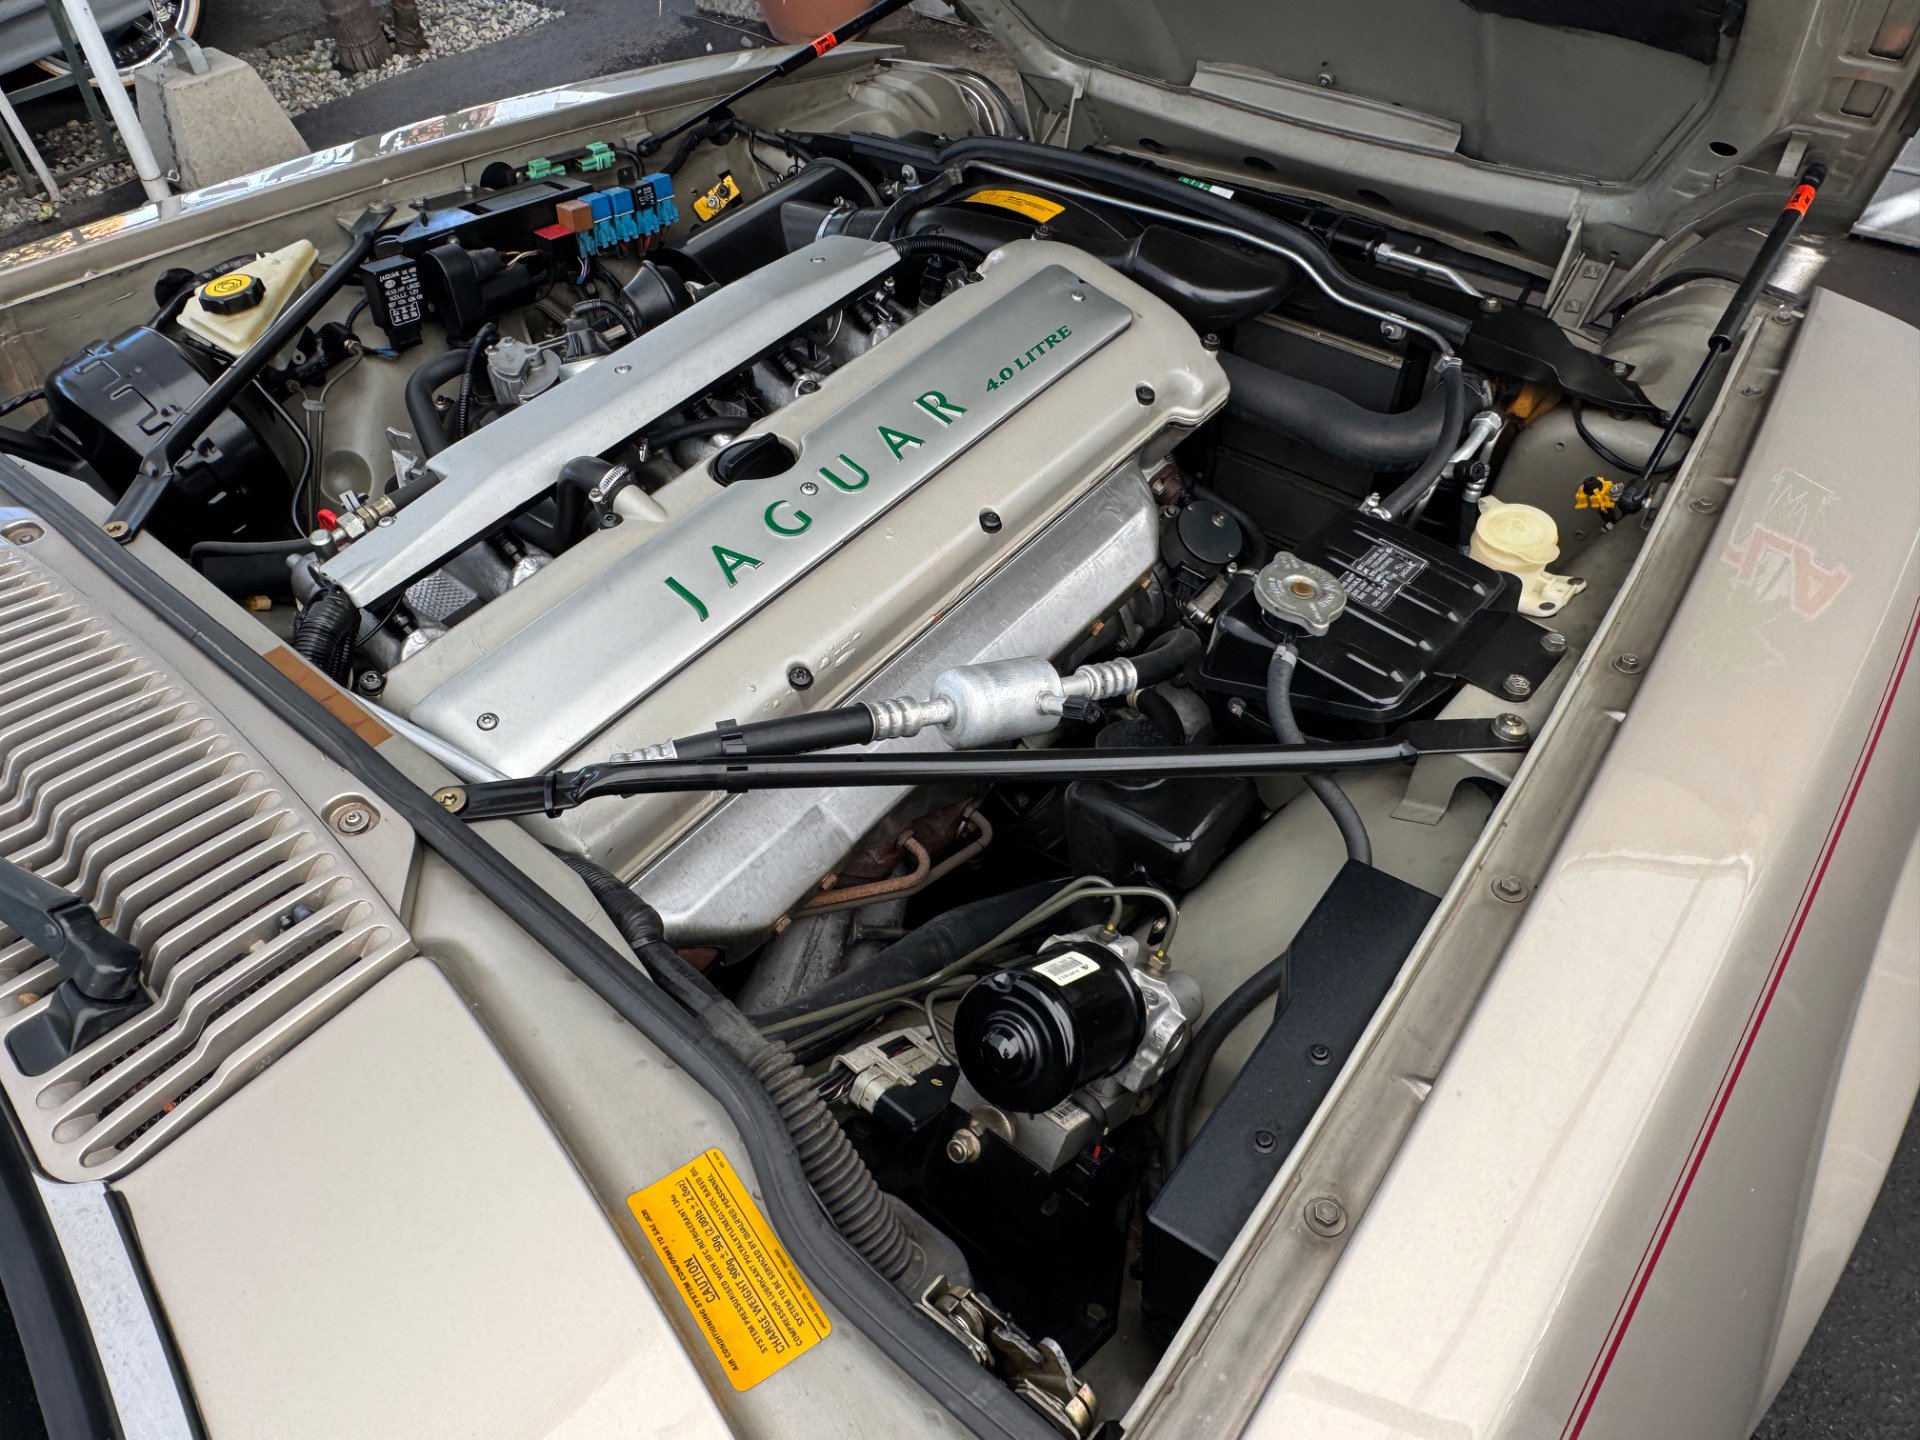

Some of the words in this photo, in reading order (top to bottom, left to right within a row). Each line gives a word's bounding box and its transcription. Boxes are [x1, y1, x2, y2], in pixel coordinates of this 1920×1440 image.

[986, 366, 1014, 392] 4.0
[1014, 325, 1072, 371] LITRE
[664, 390, 968, 622] JAGUAR
[694, 1176, 711, 1197] BASED
[705, 1172, 731, 1209] PERSONNEL
[688, 1201, 699, 1210] ±
[676, 1207, 706, 1249] REFRIGERANT
[727, 1207, 751, 1240] QUALIFIED
[656, 1235, 665, 1245] TO
[708, 1234, 726, 1252] 50g
[718, 1250, 728, 1260] ±
[746, 1238, 757, 1250] BY
[661, 1245, 687, 1281] CONFORMS
[709, 1261, 724, 1280] WITH
[722, 1257, 742, 1280] 900g
[752, 1248, 776, 1280] SERVICED
[682, 1256, 717, 1304] CAUTION
[682, 1280, 702, 1308] SYSTEM
[748, 1263, 775, 1301] LUBRICANT
[771, 1278, 781, 1290] BE
[777, 1288, 788, 1300] TO
[720, 1279, 751, 1325] PRESSURISED
[734, 1277, 763, 1316] WEIGHT
[770, 1299, 803, 1346] COMPRESSOR
[783, 1298, 805, 1327] SYSTEM
[697, 1308, 732, 1358] CONDITIONING
[746, 1323, 769, 1354] SYSTEM
[756, 1314, 786, 1354] CHARGE
[727, 1358, 739, 1372] AIR
